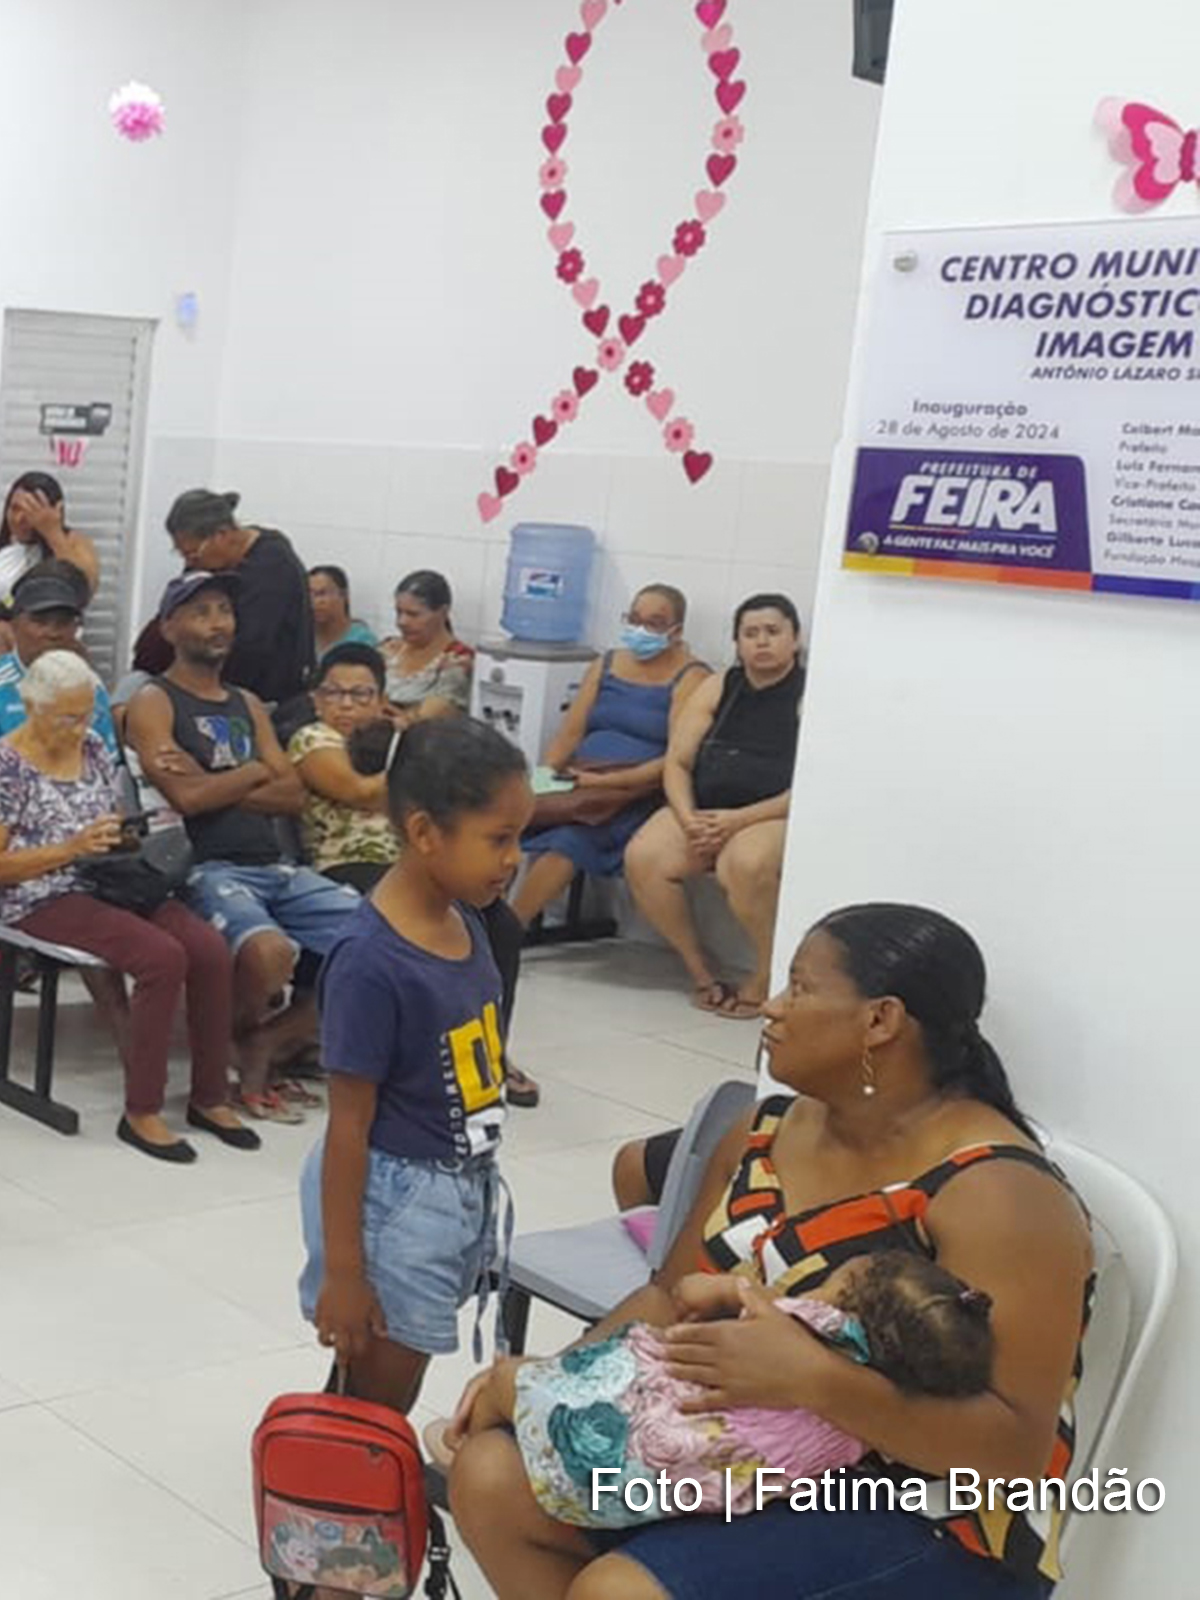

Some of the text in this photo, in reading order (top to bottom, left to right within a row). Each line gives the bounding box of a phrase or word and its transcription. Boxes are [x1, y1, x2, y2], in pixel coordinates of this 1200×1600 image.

[940, 247, 1200, 282] CENTRO MUNI
[963, 282, 1200, 320] DIAGNÓSTIC
[1034, 330, 1194, 359] IMAGEM
[1031, 364, 1109, 381] ANTÔNIO
[1185, 367, 1200, 381] S
[912, 400, 1029, 420] Inauguração
[876, 420, 1061, 440] 28 de Agosto de 2024
[919, 461, 1038, 479] PREFEITURA DE
[889, 474, 1058, 532] FEIRA
[893, 534, 933, 550] GENTE
[933, 538, 957, 551] FAZ
[956, 540, 990, 554] MAIS
